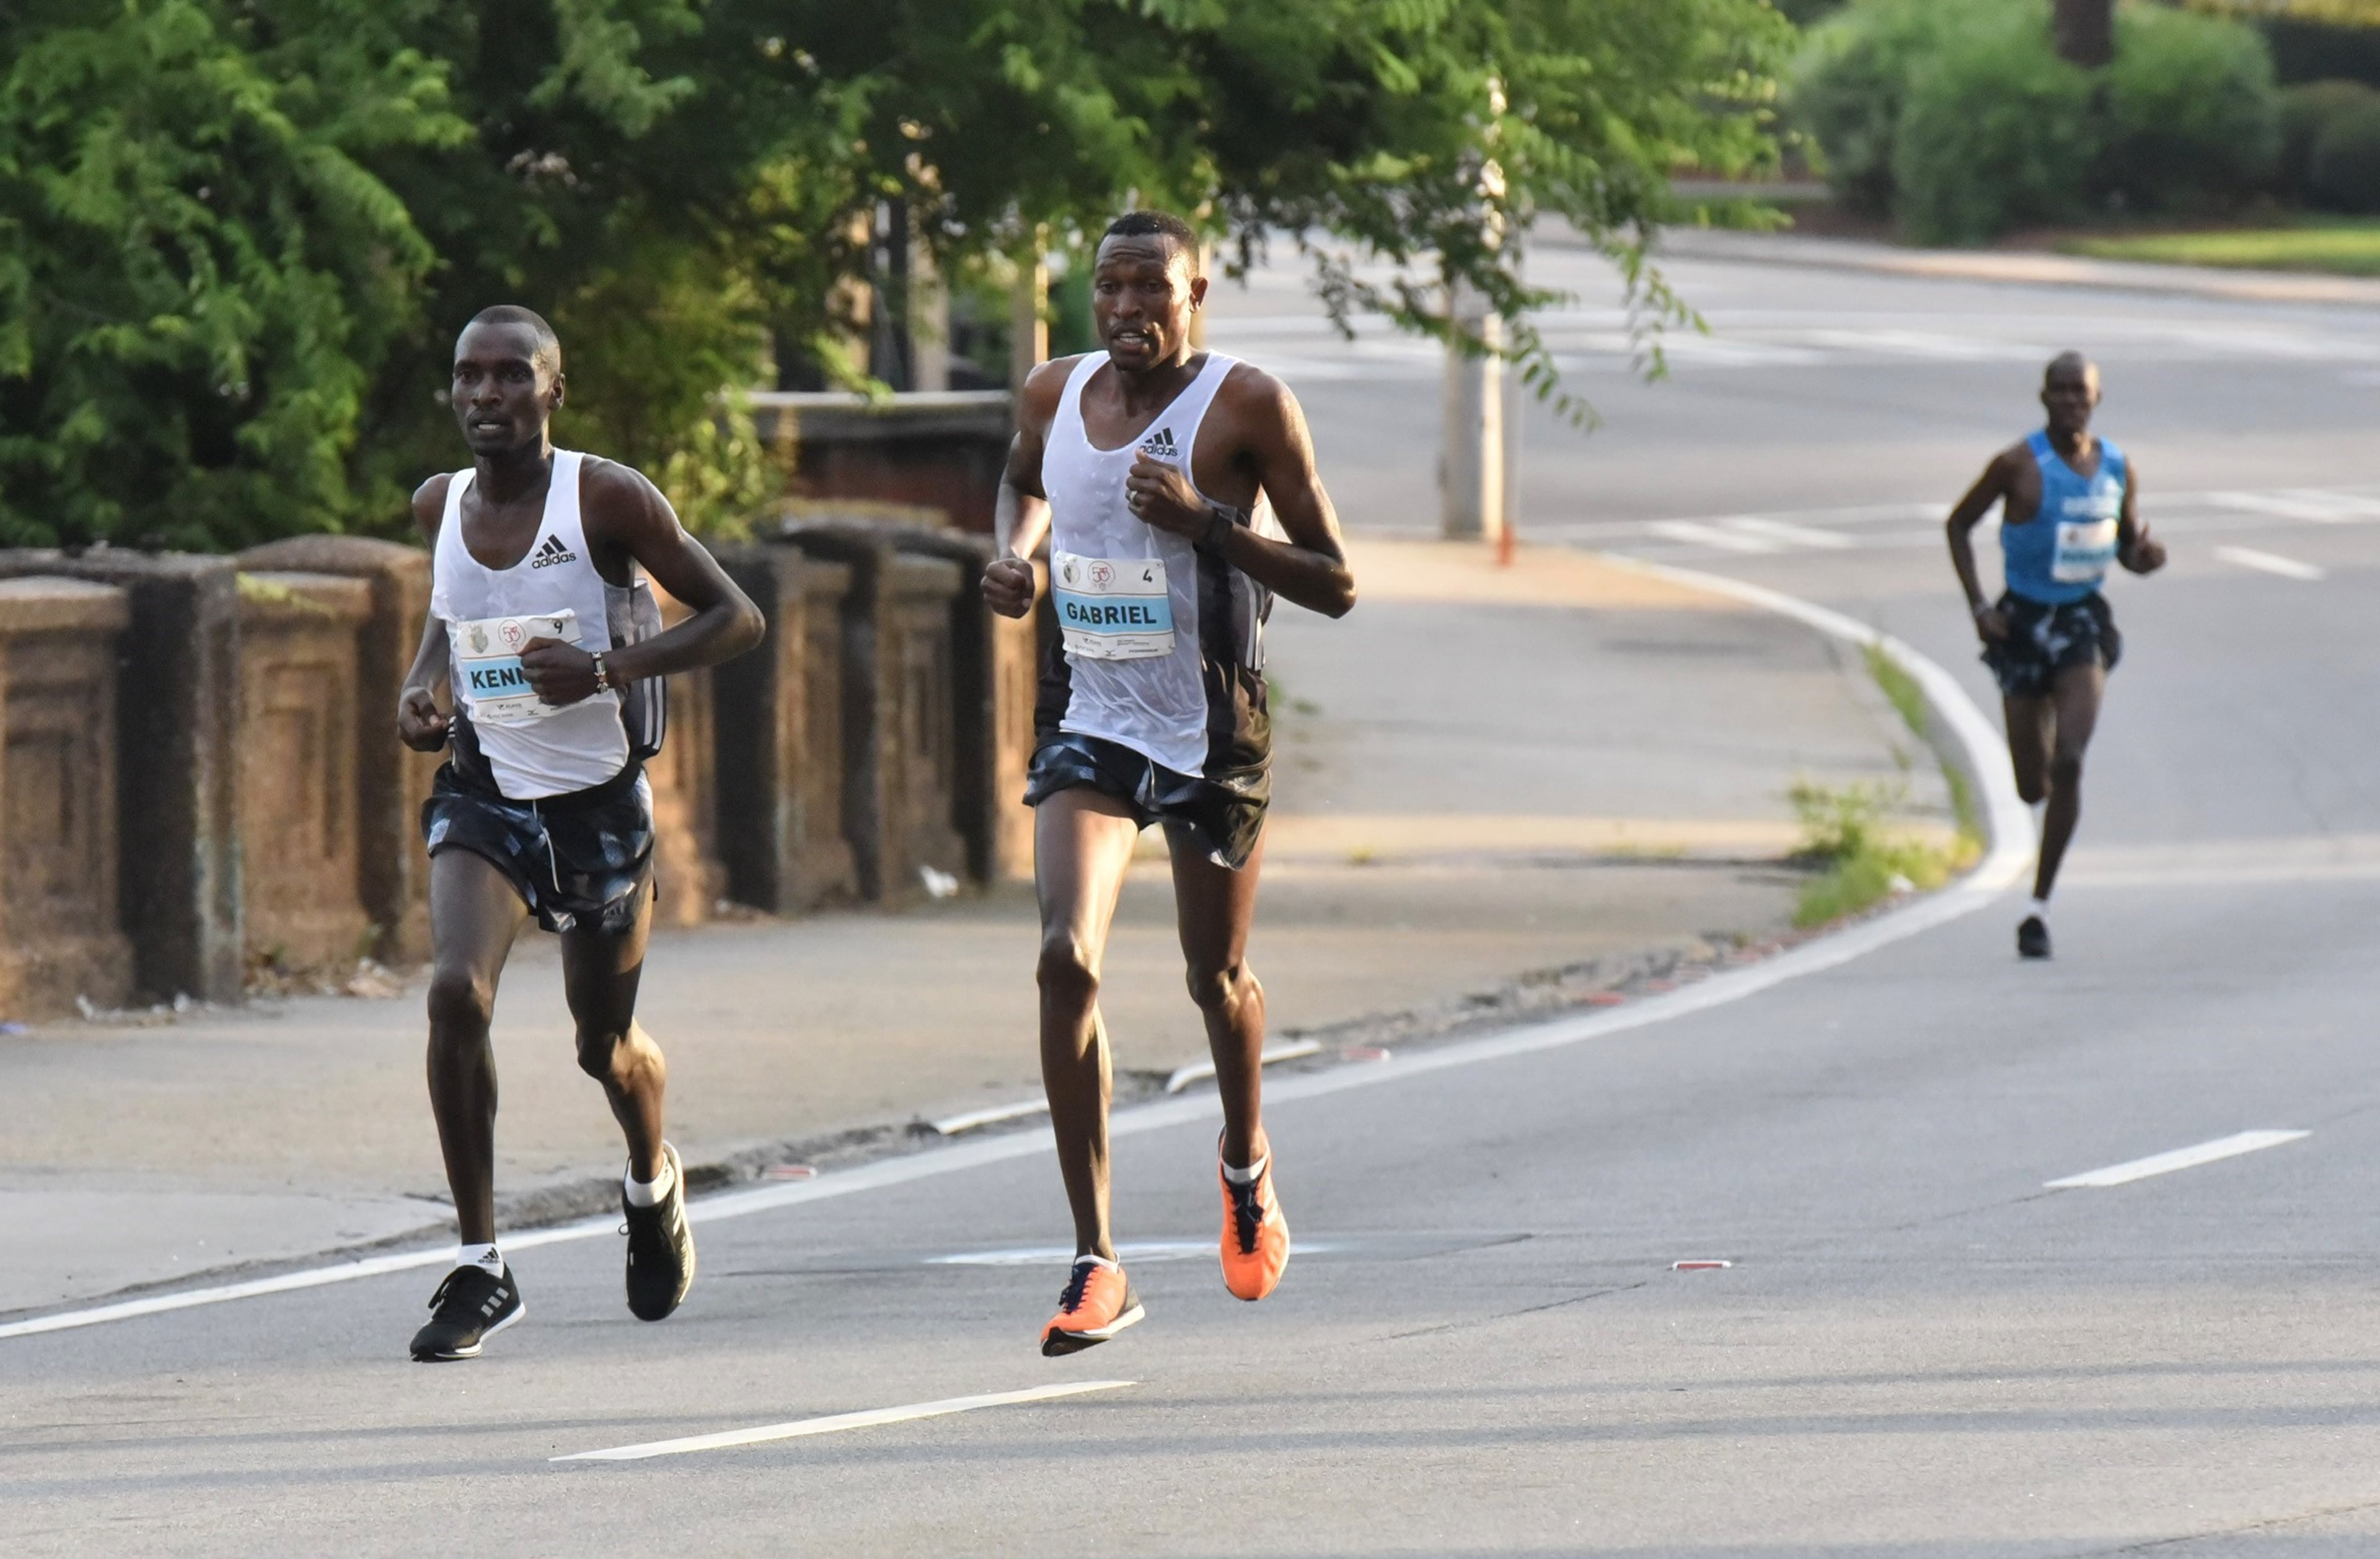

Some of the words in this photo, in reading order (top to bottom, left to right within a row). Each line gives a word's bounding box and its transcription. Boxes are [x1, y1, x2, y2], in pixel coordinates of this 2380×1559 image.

[532, 552, 577, 569] adidas
[1142, 569, 1153, 583] 4
[1067, 602, 1157, 625] GABRIEL
[554, 620, 563, 634] 9
